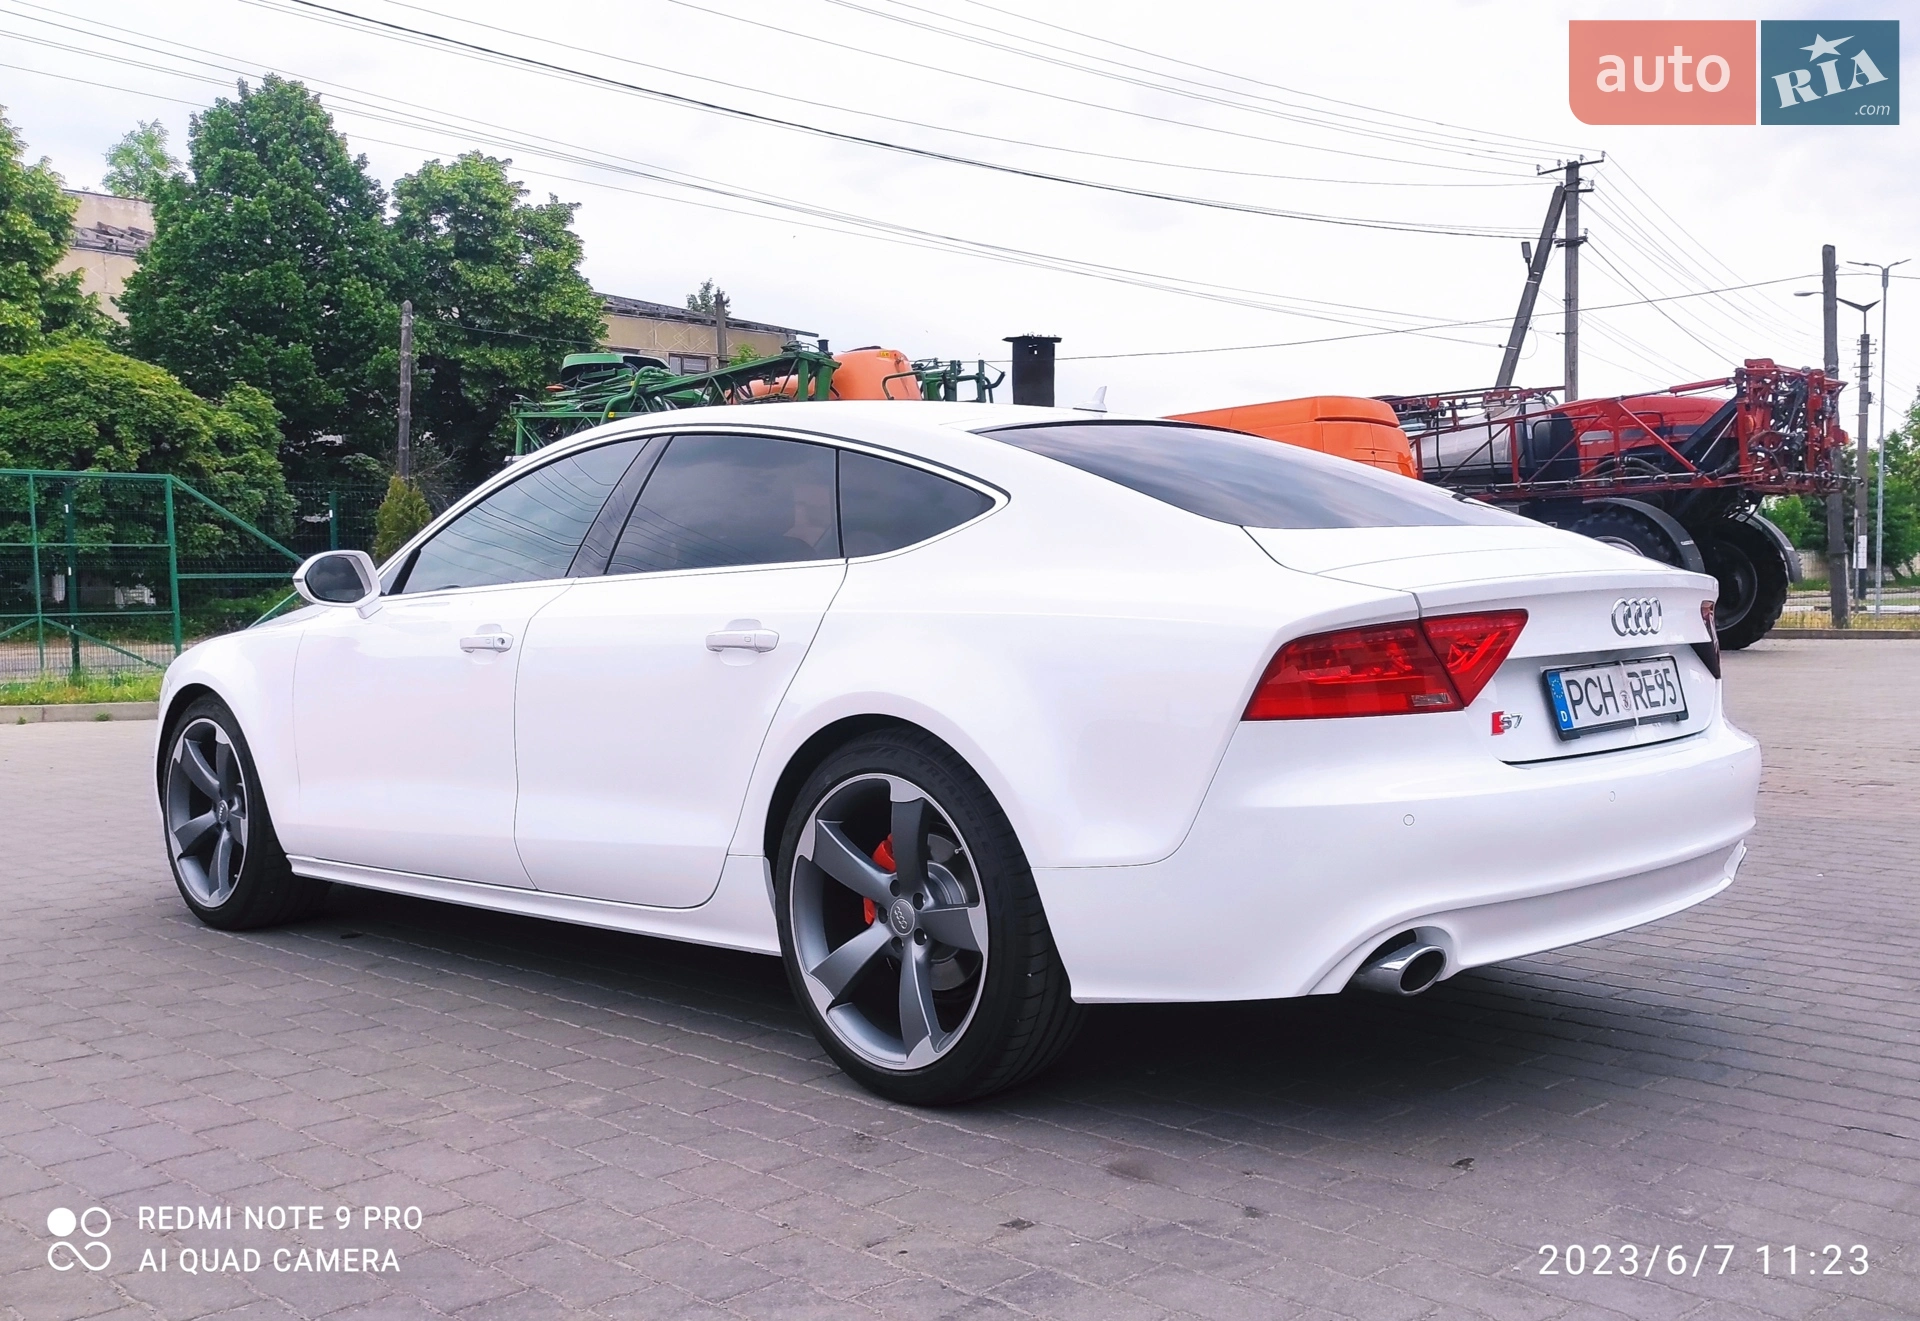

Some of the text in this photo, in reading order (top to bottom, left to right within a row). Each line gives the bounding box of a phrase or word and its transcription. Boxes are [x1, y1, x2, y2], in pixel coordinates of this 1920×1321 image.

[1565, 674, 1620, 720] PCH
[1627, 668, 1677, 711] RE95
[1499, 713, 1523, 729] S7
[1560, 710, 1568, 722] D
